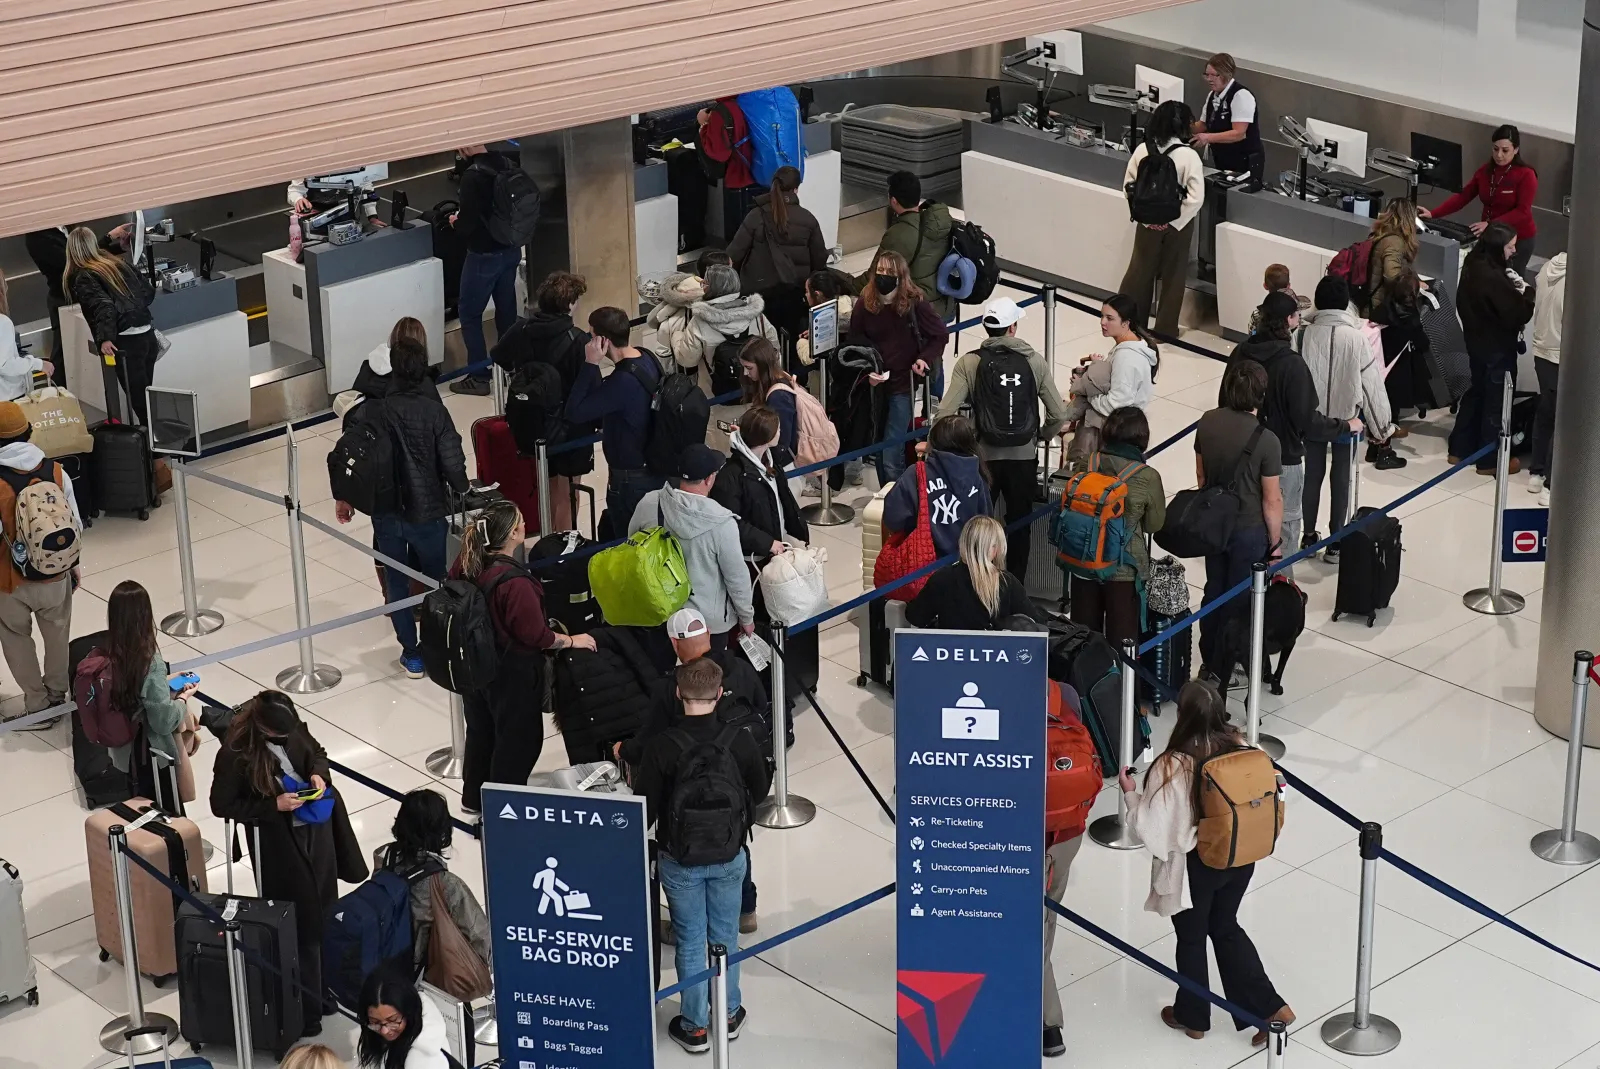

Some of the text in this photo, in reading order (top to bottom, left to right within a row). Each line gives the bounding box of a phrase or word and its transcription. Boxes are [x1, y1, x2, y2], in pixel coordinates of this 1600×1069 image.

[42, 409, 63, 419] THE
[31, 419, 56, 429] OTE
[58, 416, 80, 424] BAG
[937, 648, 1009, 662] DELTA
[909, 752, 1033, 768] AGENT ASSIST
[911, 796, 1016, 808] SERVICES OFFERED:
[526, 807, 603, 825] DELTA
[931, 817, 984, 828] Re-Ticketing
[931, 840, 1031, 852] Checked Specialty Items
[931, 863, 1029, 874] Unaccompanied Minors
[931, 885, 987, 895] Carry-on Pets
[931, 908, 1002, 918] Agent Assistance
[506, 926, 633, 952] SELF-SERVICE
[522, 946, 620, 968] BAG DROP
[515, 992, 595, 1009] PLEASE HAVE:
[543, 1017, 608, 1031] Boarding Pass
[545, 1041, 602, 1054] Bags Tagged
